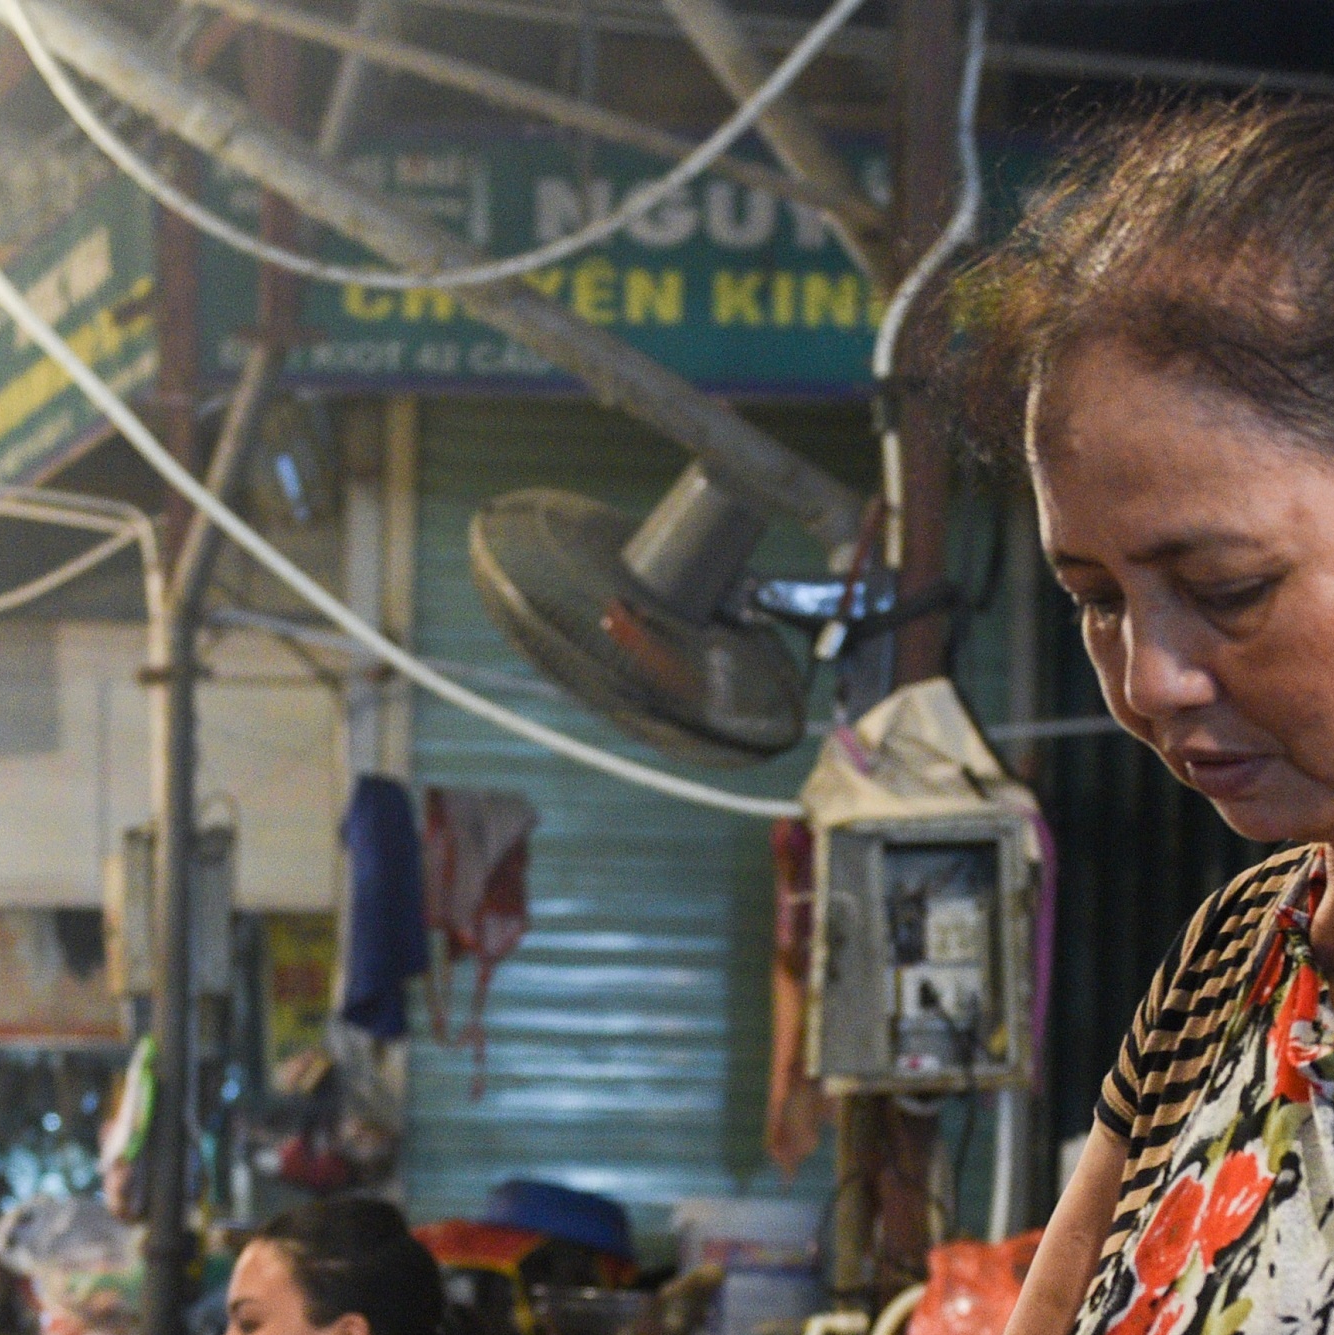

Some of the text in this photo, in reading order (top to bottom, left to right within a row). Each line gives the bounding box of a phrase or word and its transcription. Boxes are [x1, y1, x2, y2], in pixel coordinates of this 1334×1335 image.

[533, 172, 889, 250] NGUY
[341, 257, 883, 329] CHYÊN KIN
